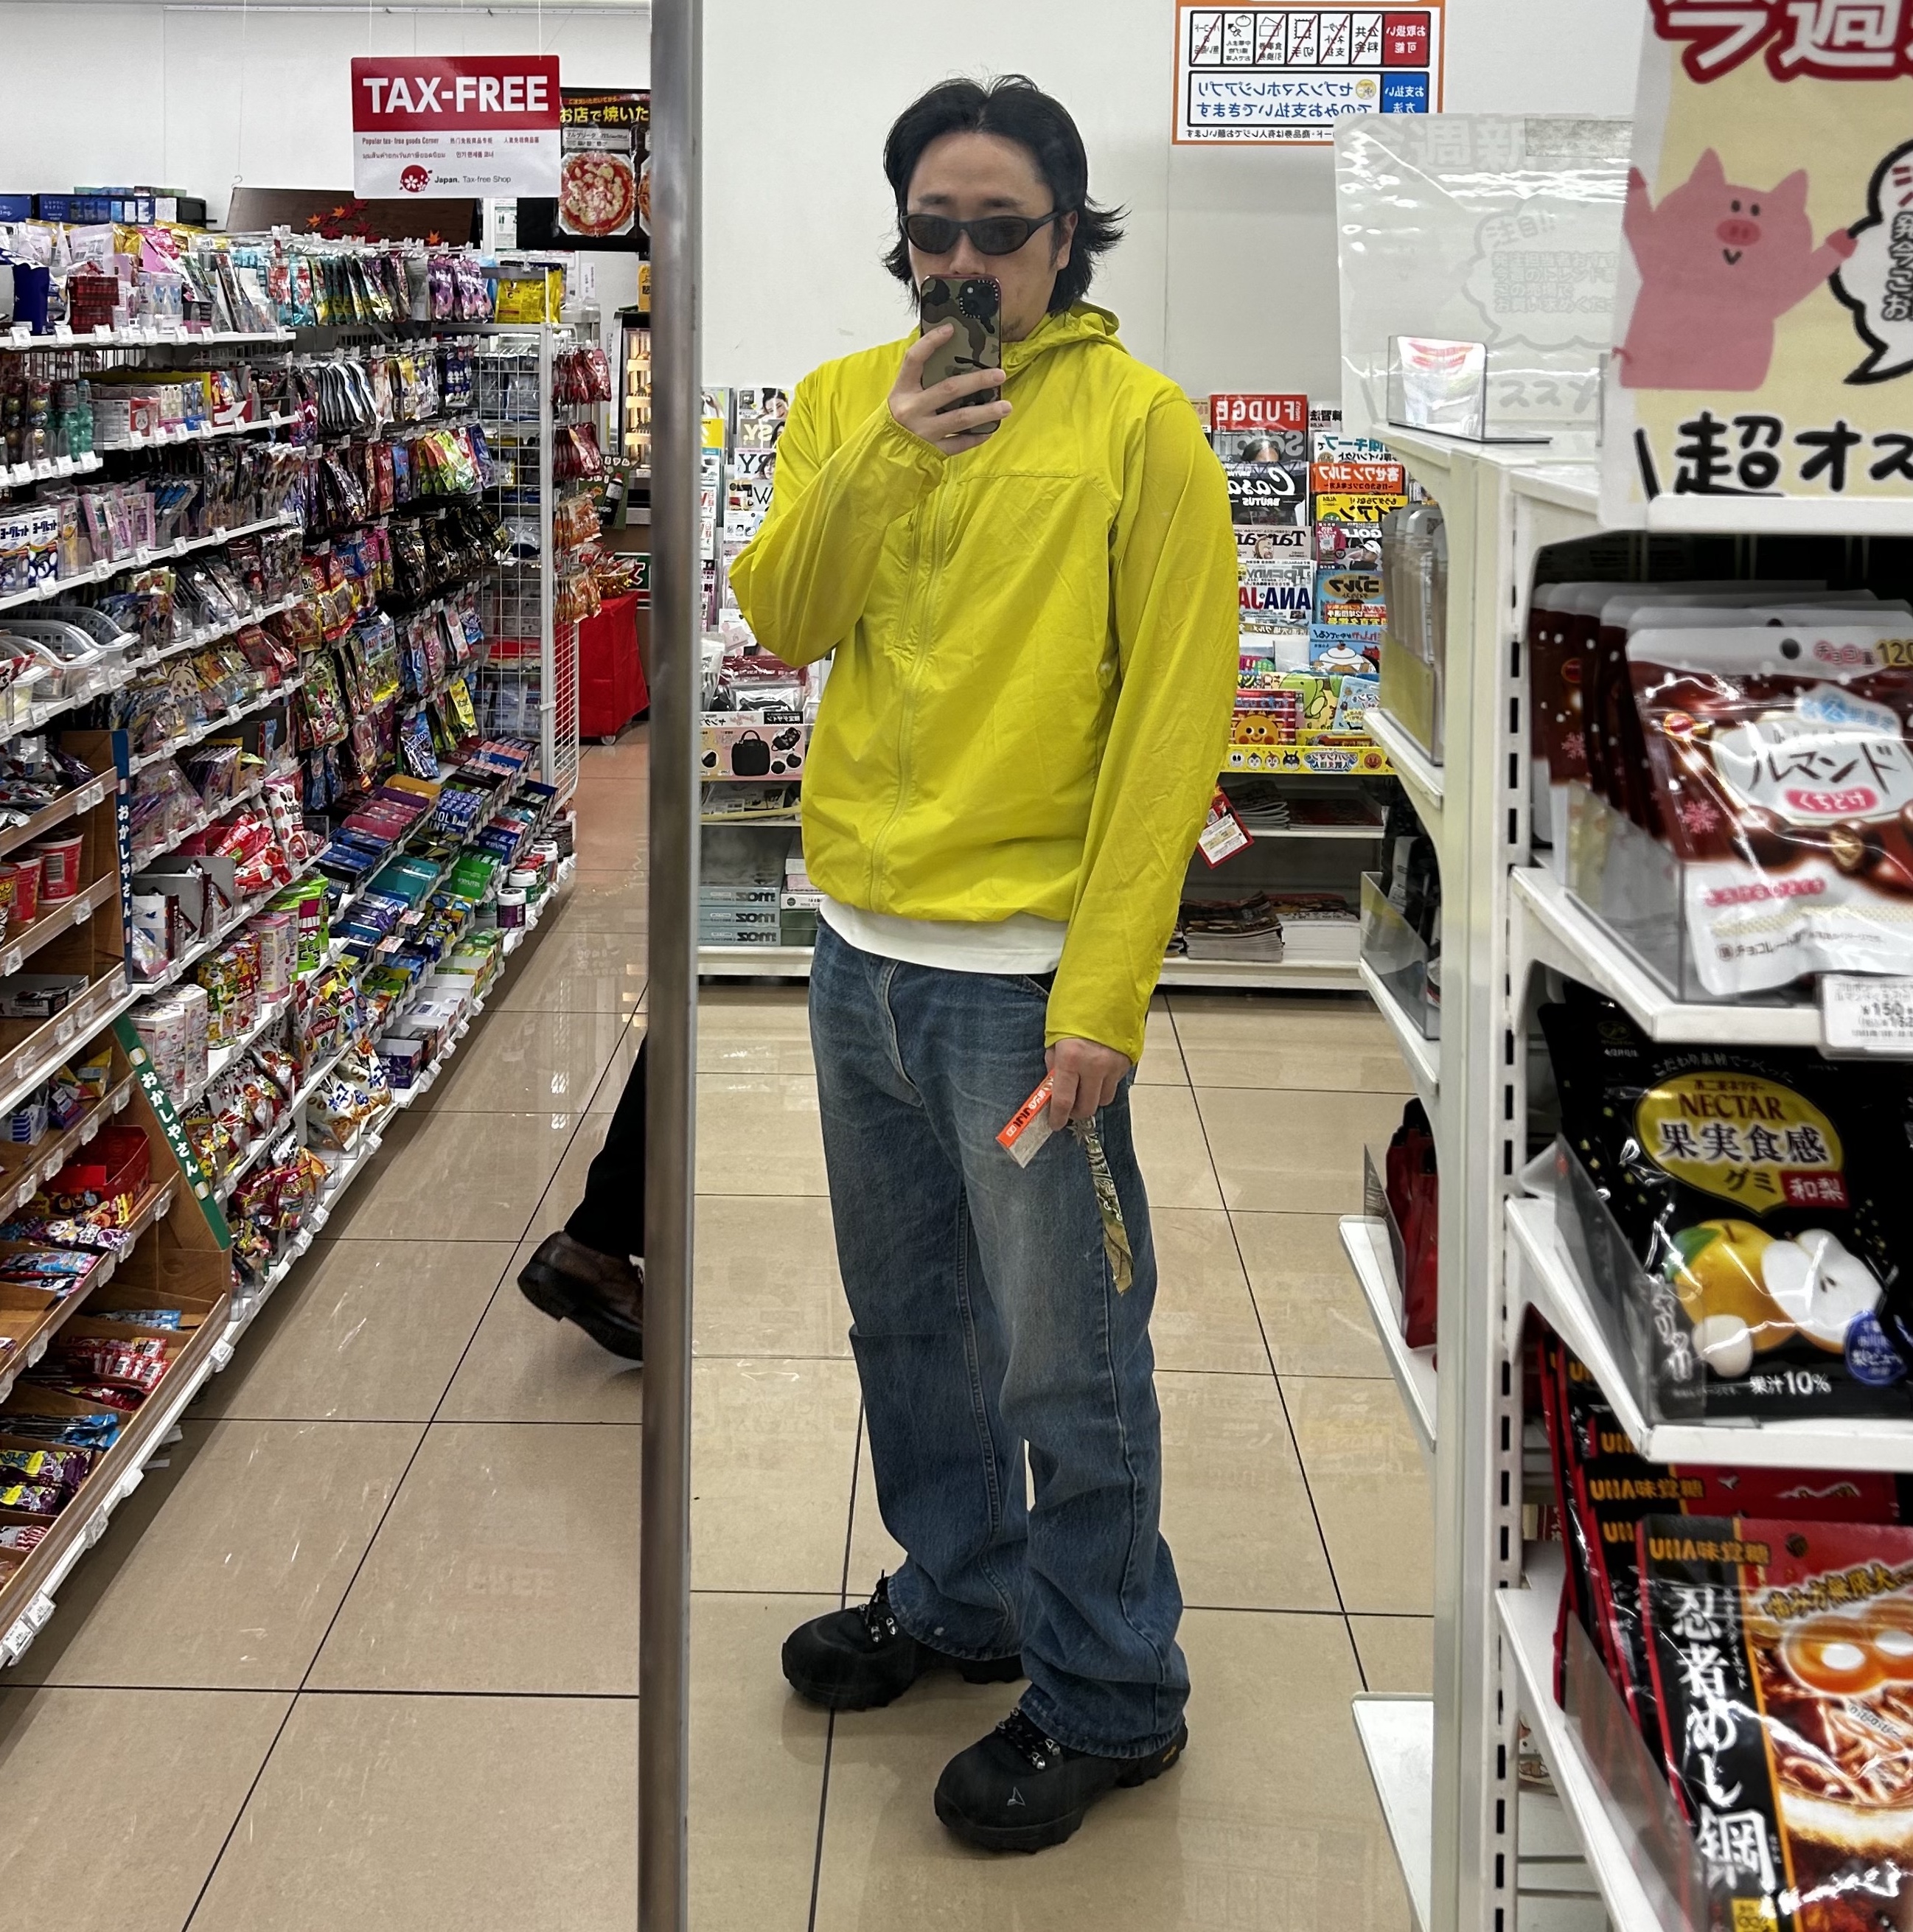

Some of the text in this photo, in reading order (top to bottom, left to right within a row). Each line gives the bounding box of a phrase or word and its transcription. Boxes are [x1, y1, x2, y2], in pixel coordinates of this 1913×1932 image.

[362, 76, 549, 114] TAX-FREE
[560, 105, 649, 123] お店で焼いた
[434, 175, 512, 184] Japan. Tax-free Shop
[118, 805, 133, 919] おかしやさん
[1679, 1092, 1788, 1121] NECTAR
[141, 1072, 198, 1177] おかしやさん
[1659, 1122, 1828, 1165] 果実食感
[1726, 1168, 1778, 1194] グミ
[1789, 1178, 1846, 1203] 和梨
